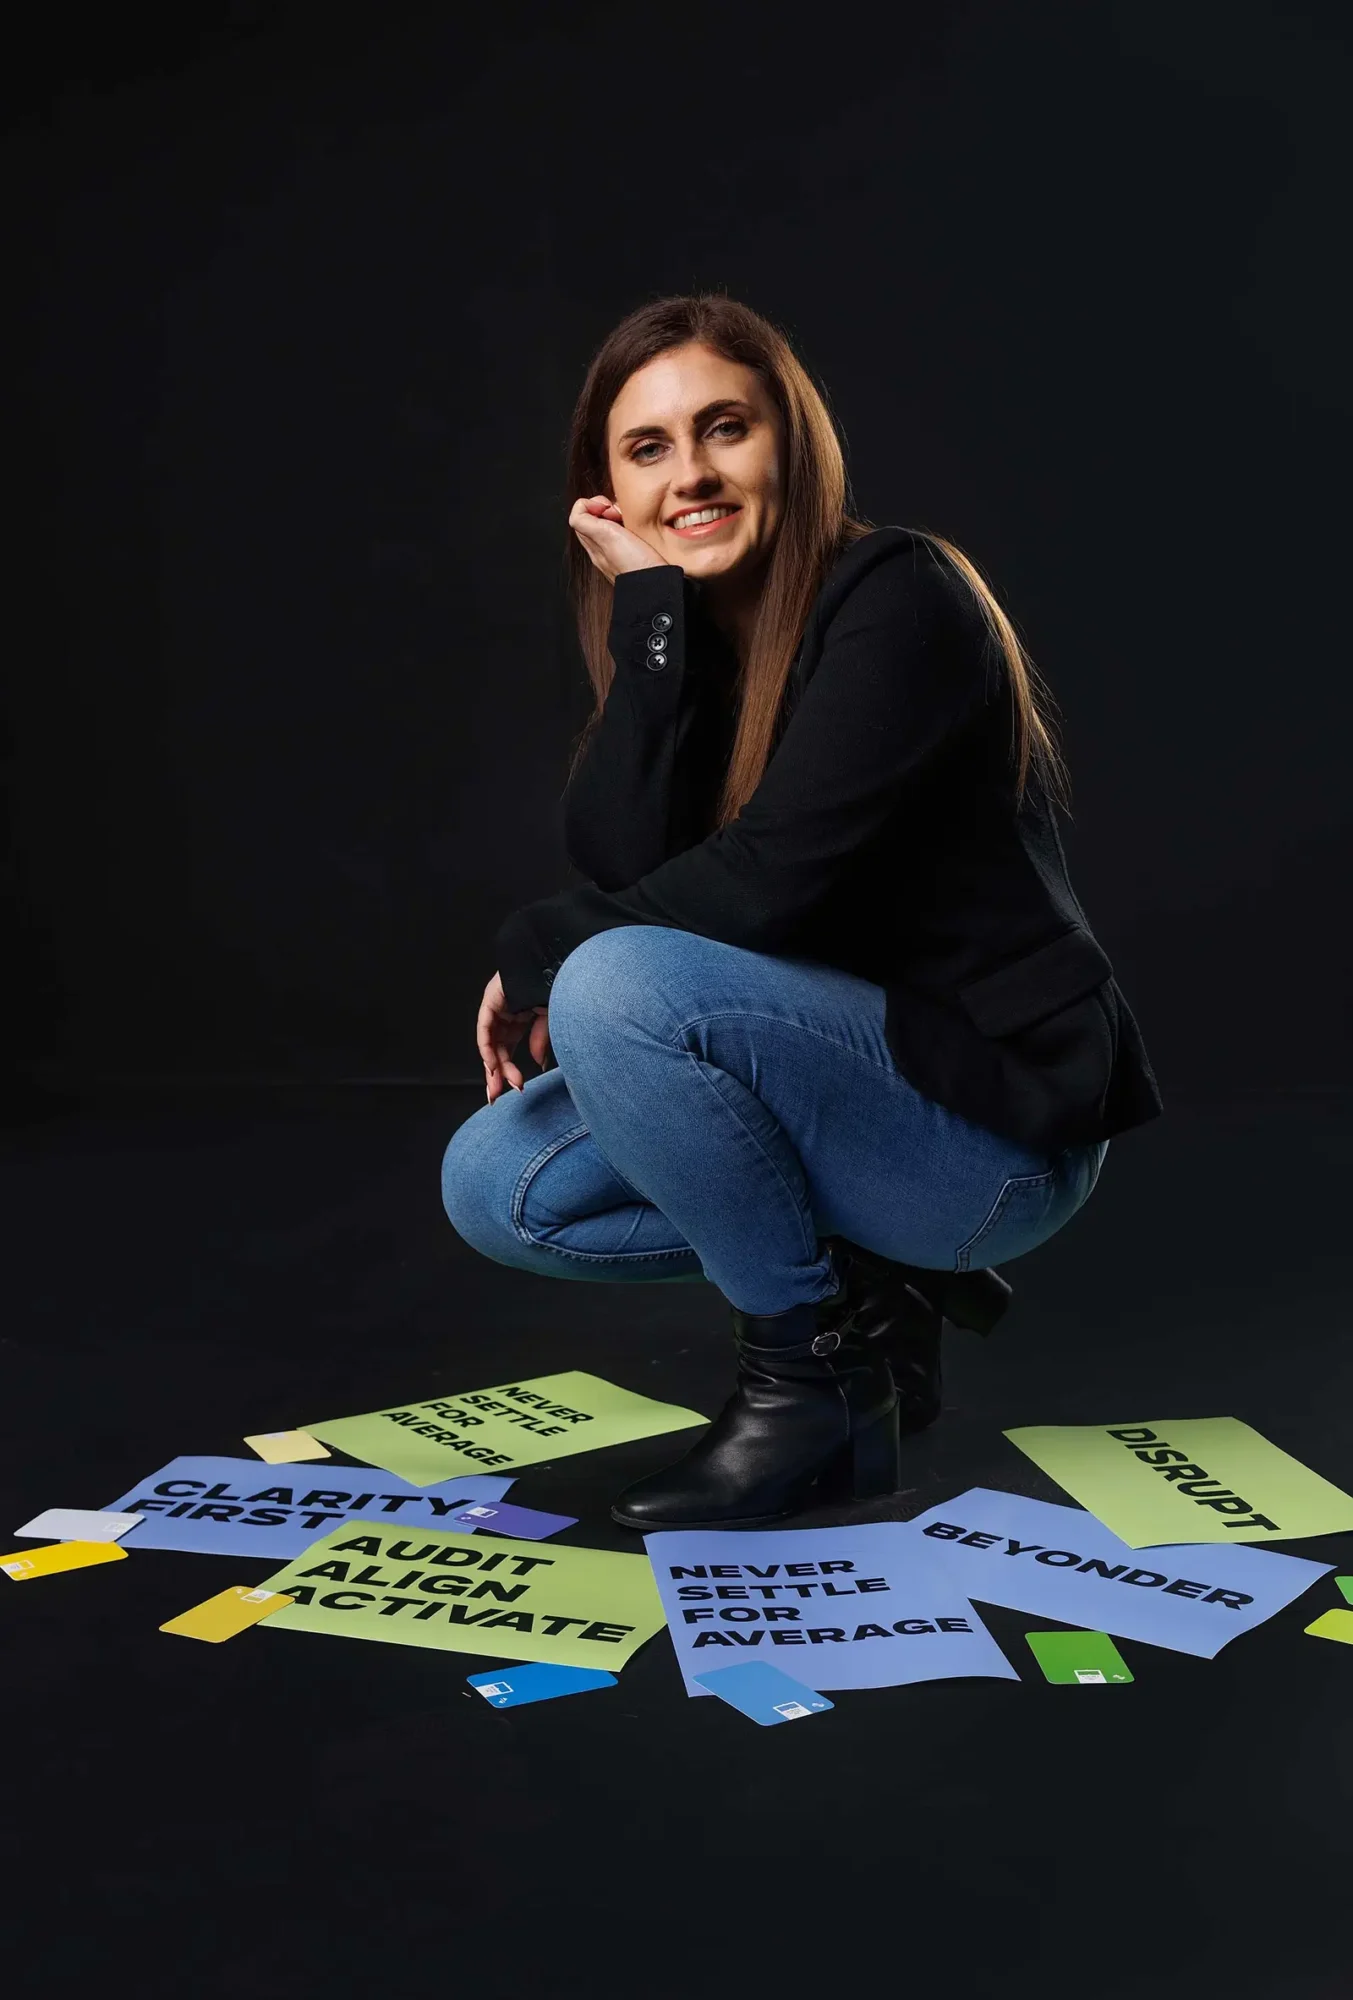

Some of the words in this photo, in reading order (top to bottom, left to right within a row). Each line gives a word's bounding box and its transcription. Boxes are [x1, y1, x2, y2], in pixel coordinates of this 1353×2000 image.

[420, 1402, 485, 1428] FOR
[459, 1395, 568, 1436] SETTLE
[496, 1387, 594, 1424] NEVER
[380, 1412, 514, 1466] AVERAGE
[153, 1480, 476, 1516] CLARITY
[1106, 1428, 1282, 1531] DISRUPT
[120, 1499, 346, 1528] FIRST
[329, 1535, 555, 1575] AUDIT
[669, 1560, 858, 1580] NEVER
[922, 1522, 1255, 1610] BEYONDER
[295, 1560, 531, 1603] ALIGN
[676, 1577, 891, 1600] SETTLE
[276, 1585, 636, 1643] ACTIVATE
[682, 1606, 803, 1624] FOR
[692, 1617, 974, 1648] AVERAGE
